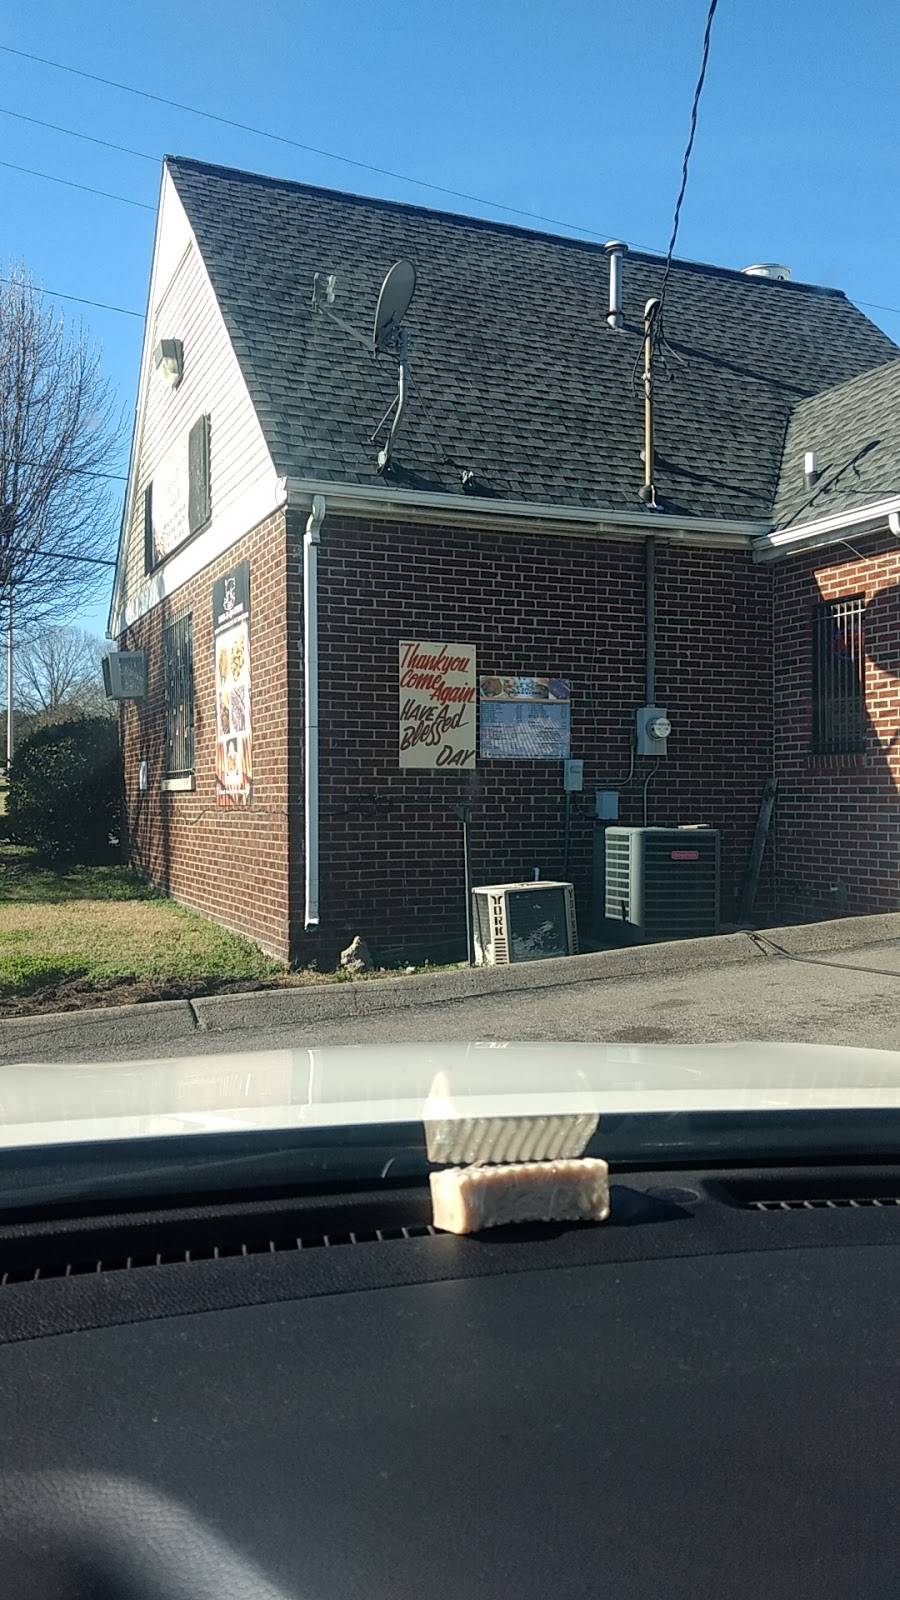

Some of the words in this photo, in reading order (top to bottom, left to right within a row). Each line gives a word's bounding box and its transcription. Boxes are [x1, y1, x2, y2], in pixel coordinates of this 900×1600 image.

[400, 669, 442, 689] Come
[429, 682, 475, 705] Again
[400, 698, 438, 721] HAVE
[435, 704, 450, 723] A
[400, 703, 469, 751] Blessed
[435, 745, 475, 766] DAY
[490, 895, 504, 936] YORK
